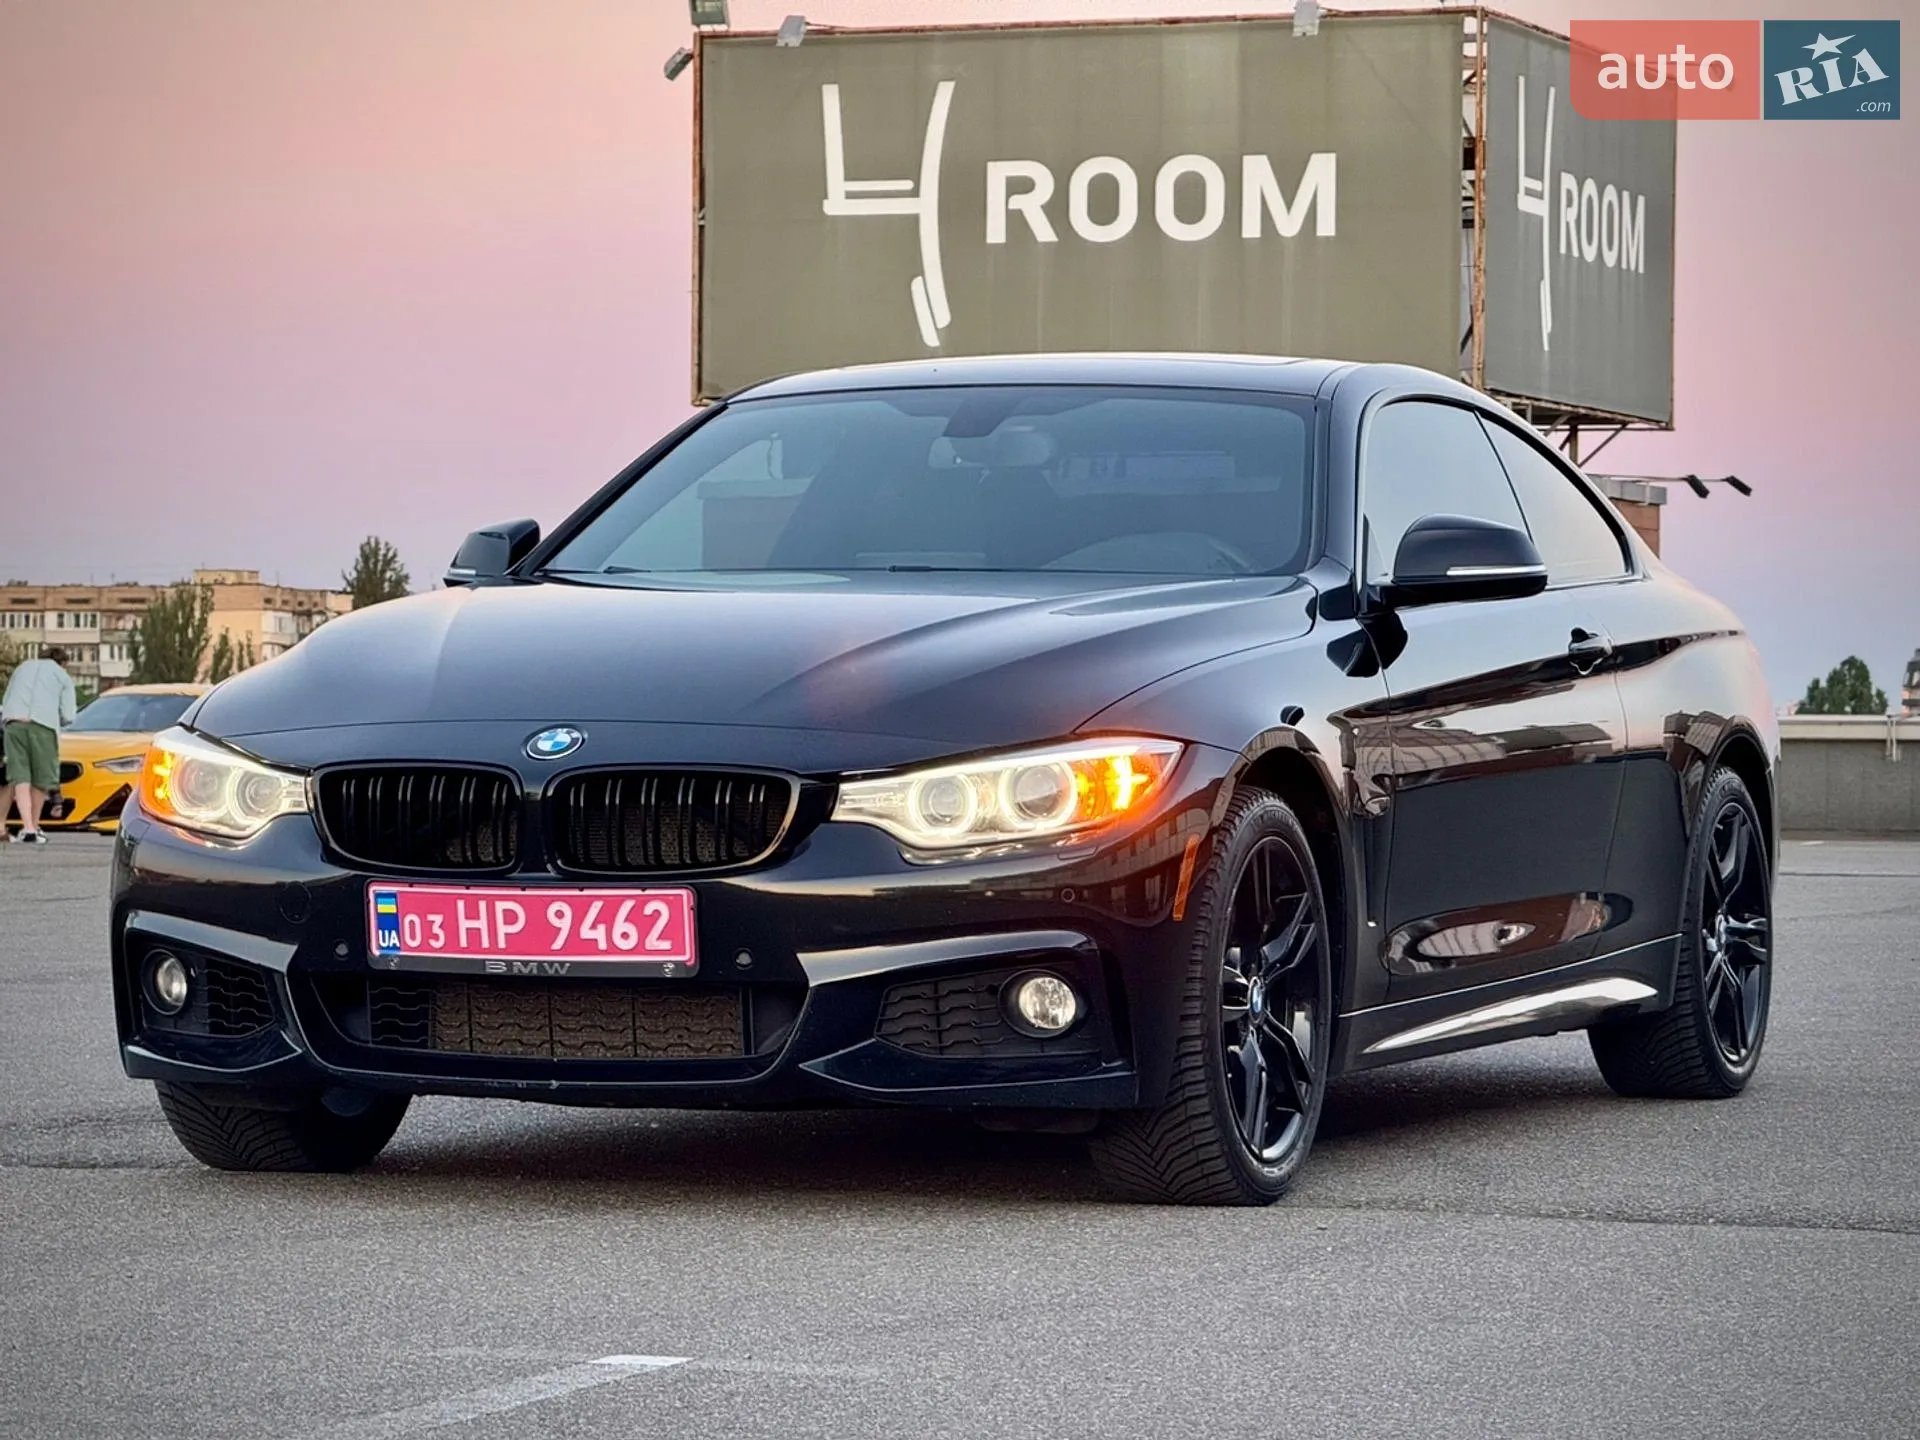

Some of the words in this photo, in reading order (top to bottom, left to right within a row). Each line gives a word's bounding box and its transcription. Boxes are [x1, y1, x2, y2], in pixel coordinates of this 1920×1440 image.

[986, 152, 1337, 243] ROOM
[1559, 171, 1645, 274] ROOM
[378, 929, 400, 948] UA
[403, 913, 446, 949] 03
[456, 899, 526, 949] HP
[546, 899, 673, 951] 9462
[484, 960, 570, 975] BMW
